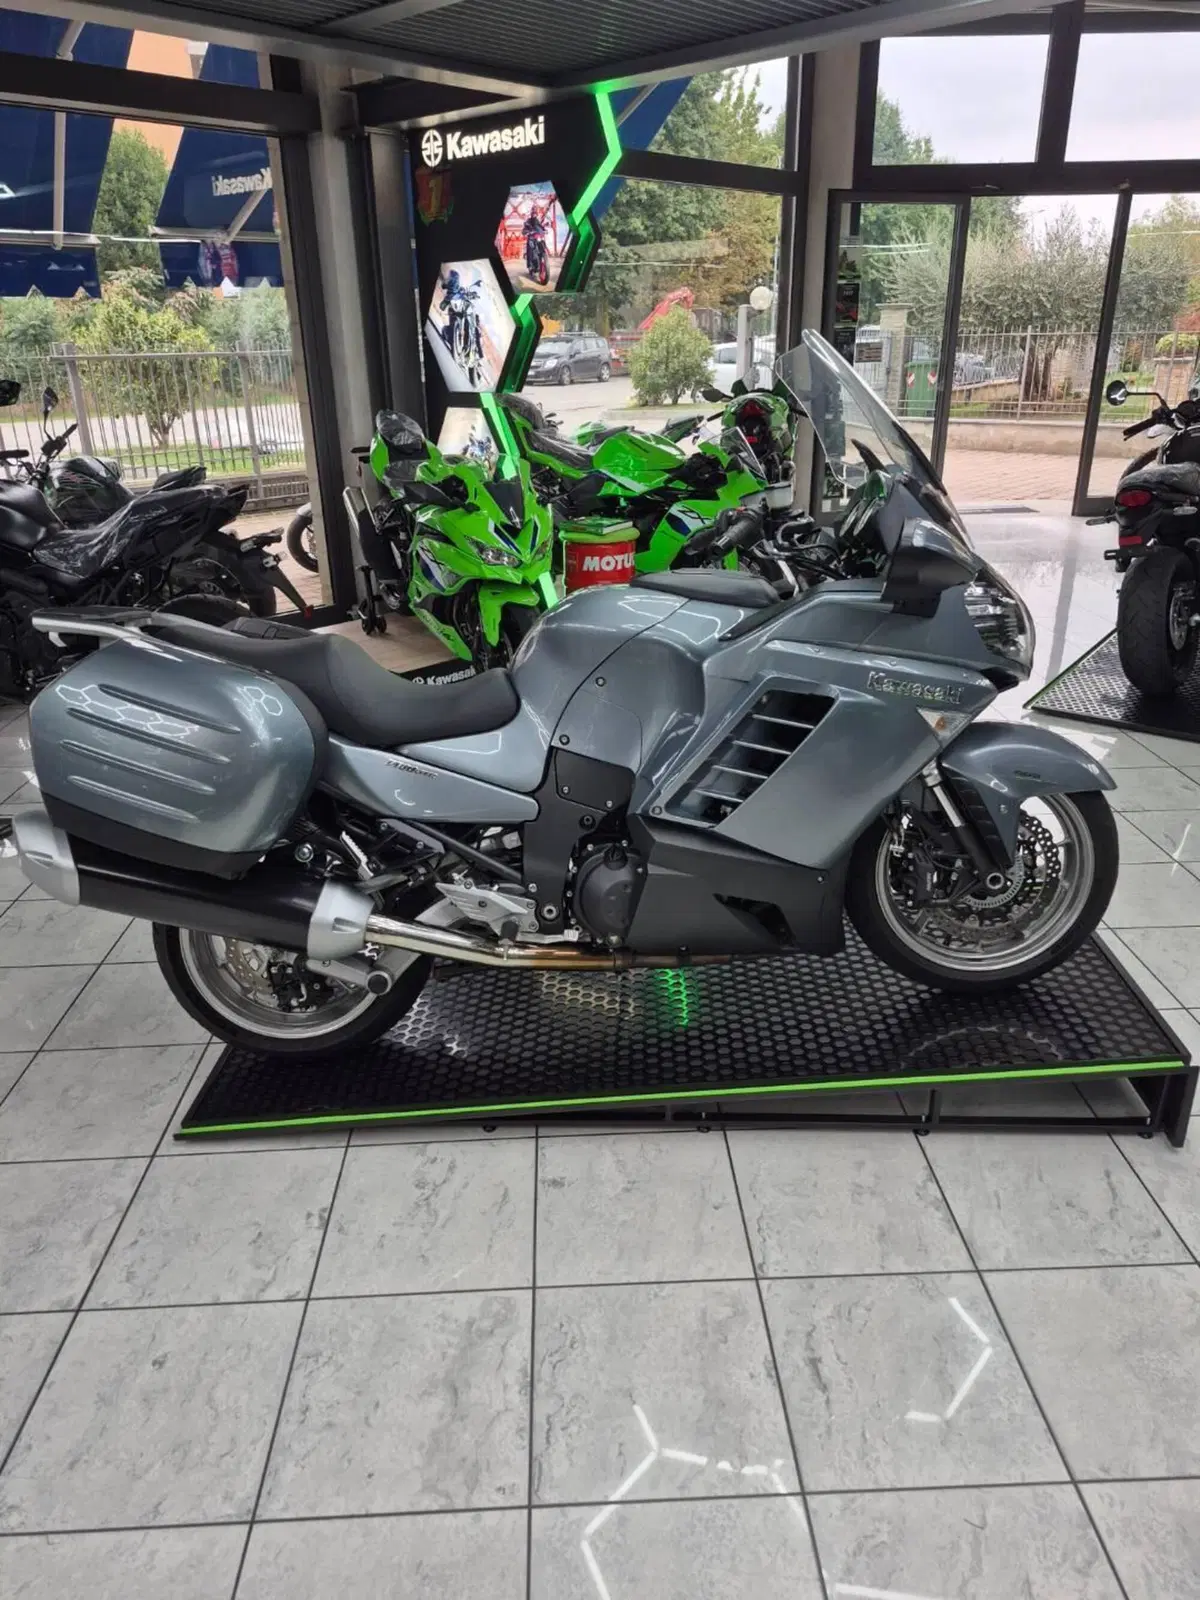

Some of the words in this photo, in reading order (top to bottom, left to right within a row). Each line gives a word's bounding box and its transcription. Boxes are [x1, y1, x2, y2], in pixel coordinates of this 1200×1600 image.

[446, 115, 545, 160] Kawasaki
[582, 552, 635, 572] MOTU
[427, 665, 477, 685] Kawasak
[867, 671, 965, 704] Kawasaki
